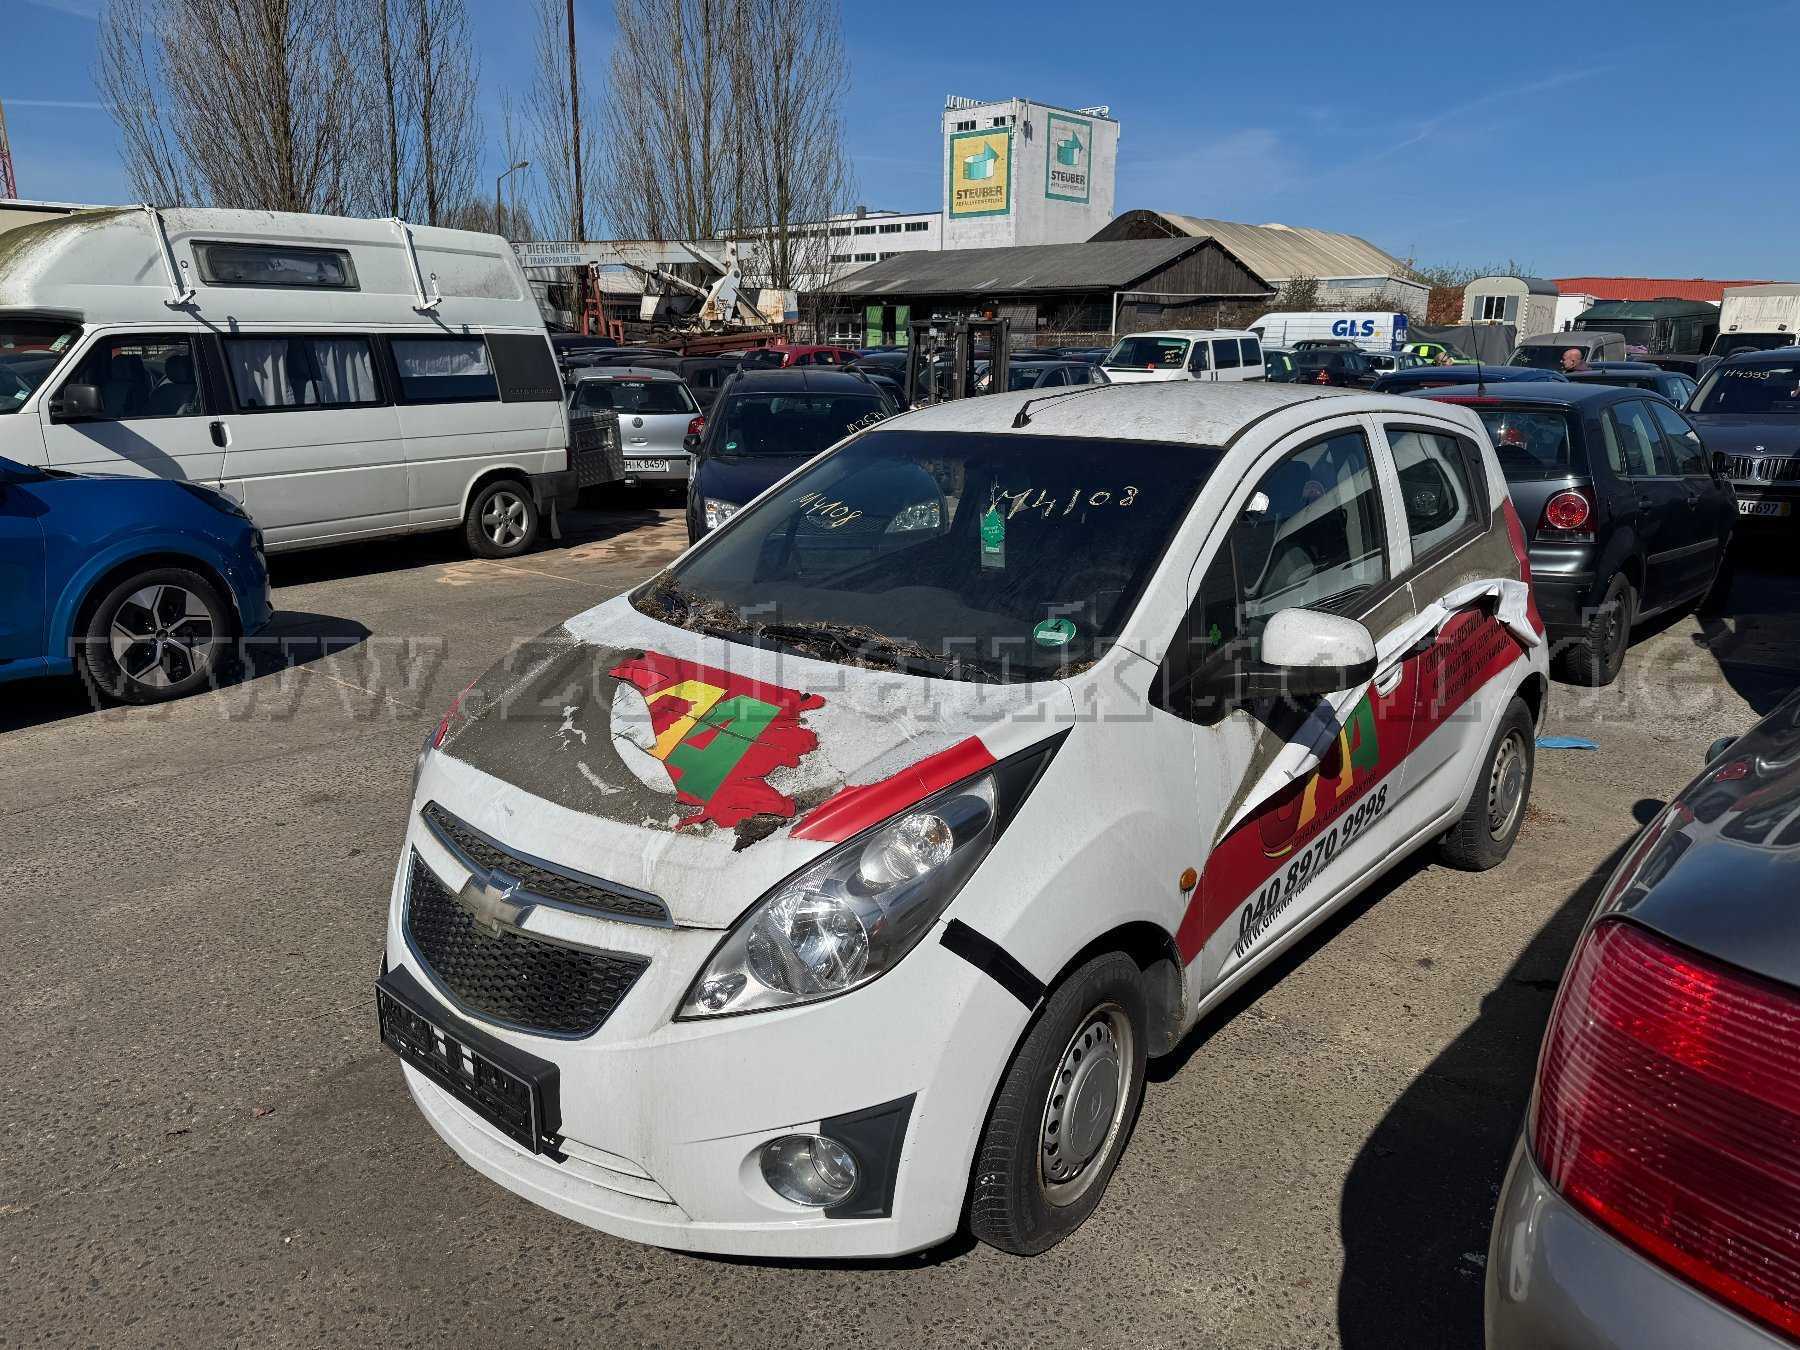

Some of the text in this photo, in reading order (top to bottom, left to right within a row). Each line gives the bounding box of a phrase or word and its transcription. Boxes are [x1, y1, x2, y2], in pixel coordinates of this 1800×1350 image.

[1051, 170, 1085, 185] STEUBER
[956, 185, 1003, 199] STEUBER
[1395, 329, 1407, 341] GLS
[1239, 877, 1281, 937] 040
[1284, 827, 1338, 895] 8970
[1341, 783, 1388, 847] 9998
